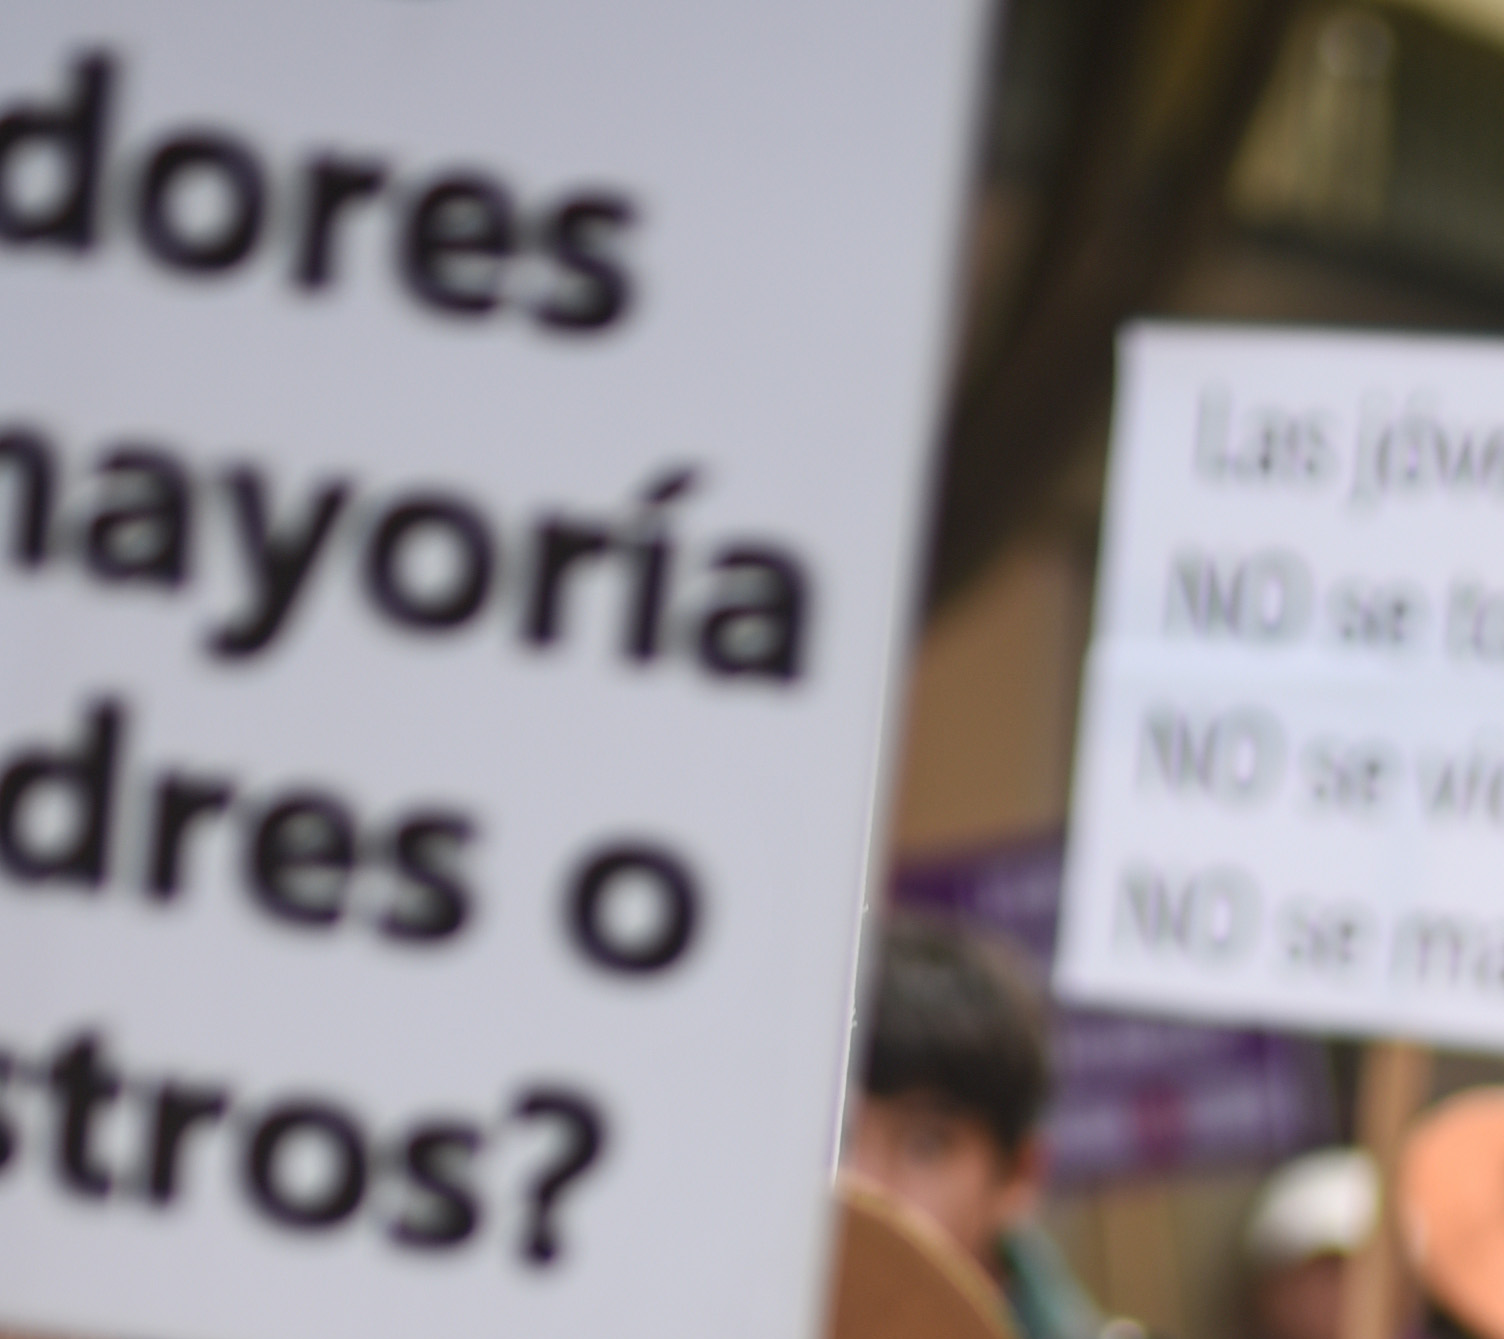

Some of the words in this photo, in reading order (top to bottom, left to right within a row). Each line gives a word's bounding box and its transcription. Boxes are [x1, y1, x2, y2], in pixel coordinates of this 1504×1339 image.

[1194, 392, 1336, 486] Las
[1163, 547, 1312, 647] NO
[1330, 586, 1414, 660] se
[1136, 704, 1286, 811] NO
[1311, 746, 1396, 818] se
[556, 832, 707, 978] o
[1111, 862, 1266, 968] NO
[1284, 904, 1371, 976] se
